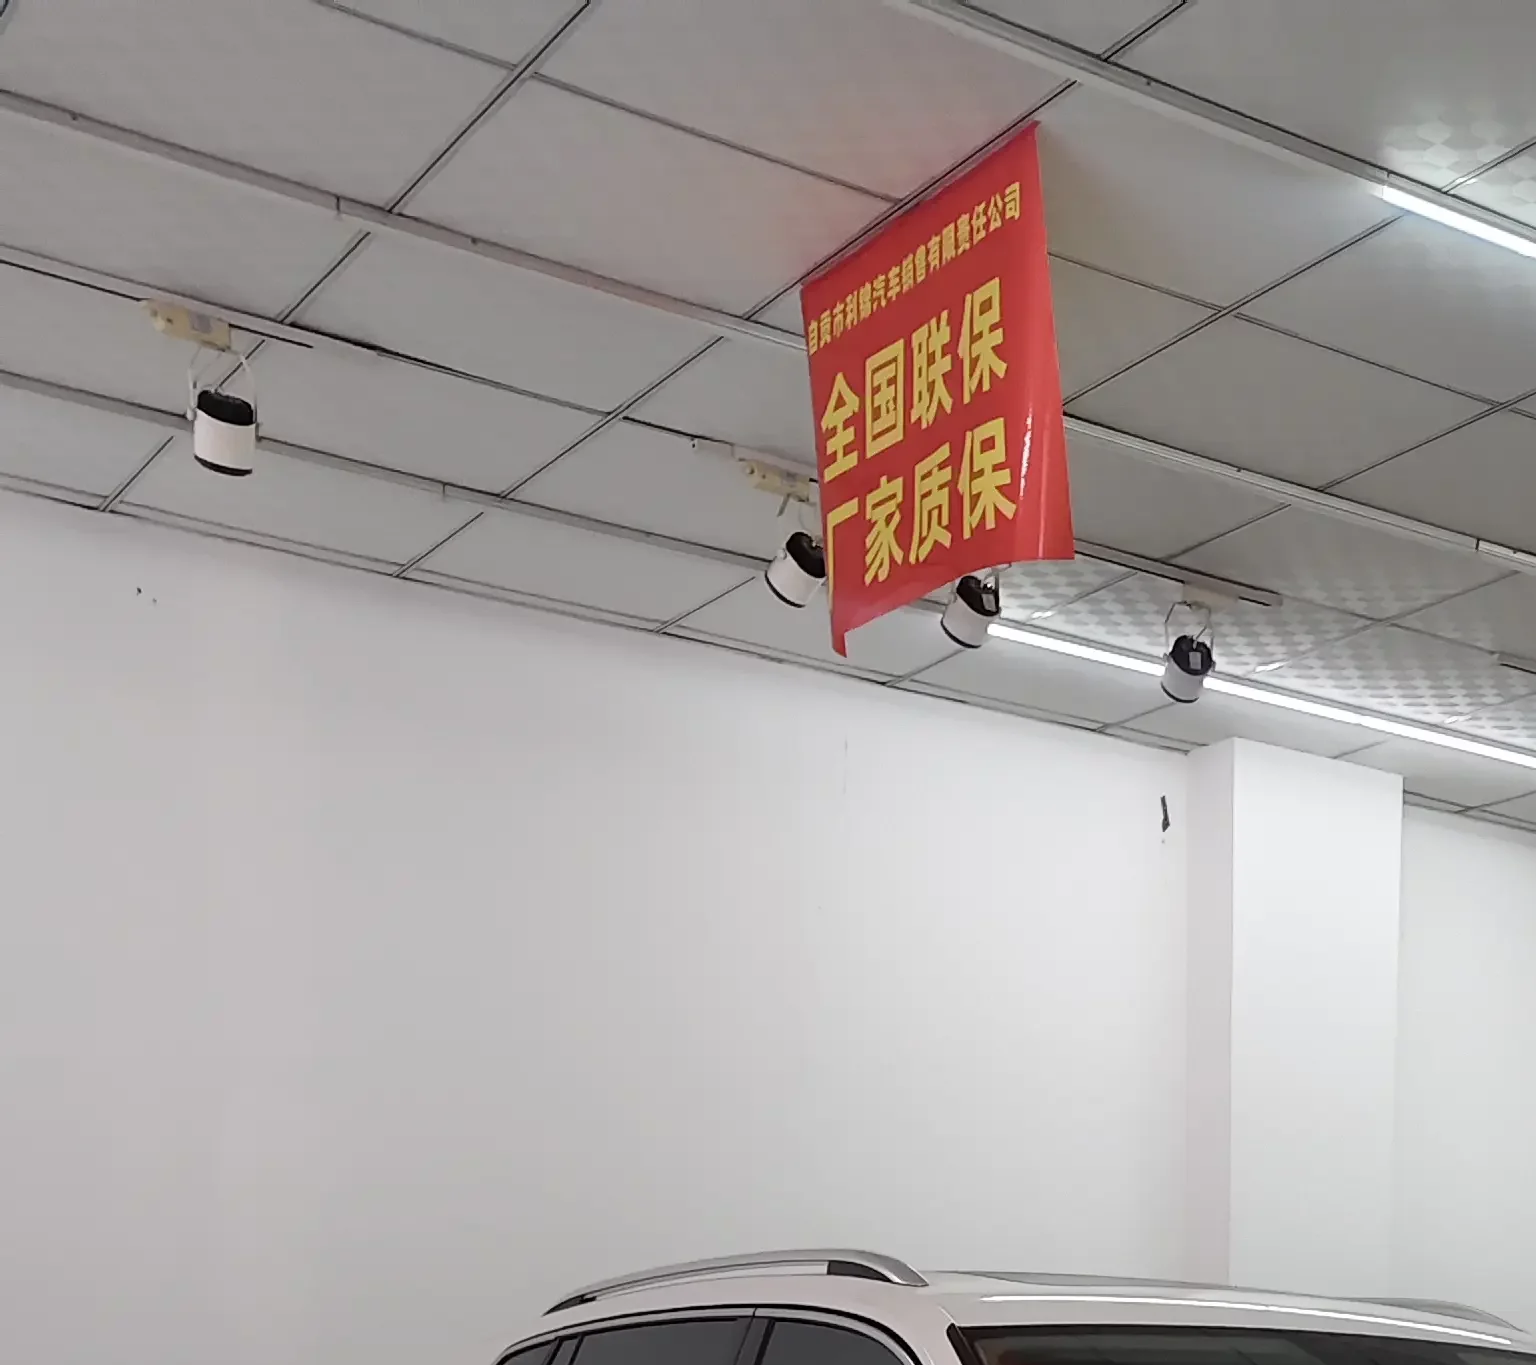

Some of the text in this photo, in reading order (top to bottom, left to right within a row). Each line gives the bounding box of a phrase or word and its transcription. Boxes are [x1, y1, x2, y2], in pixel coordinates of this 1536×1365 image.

[821, 277, 1008, 483] 全国联保
[827, 417, 1016, 613] 厂家质保
